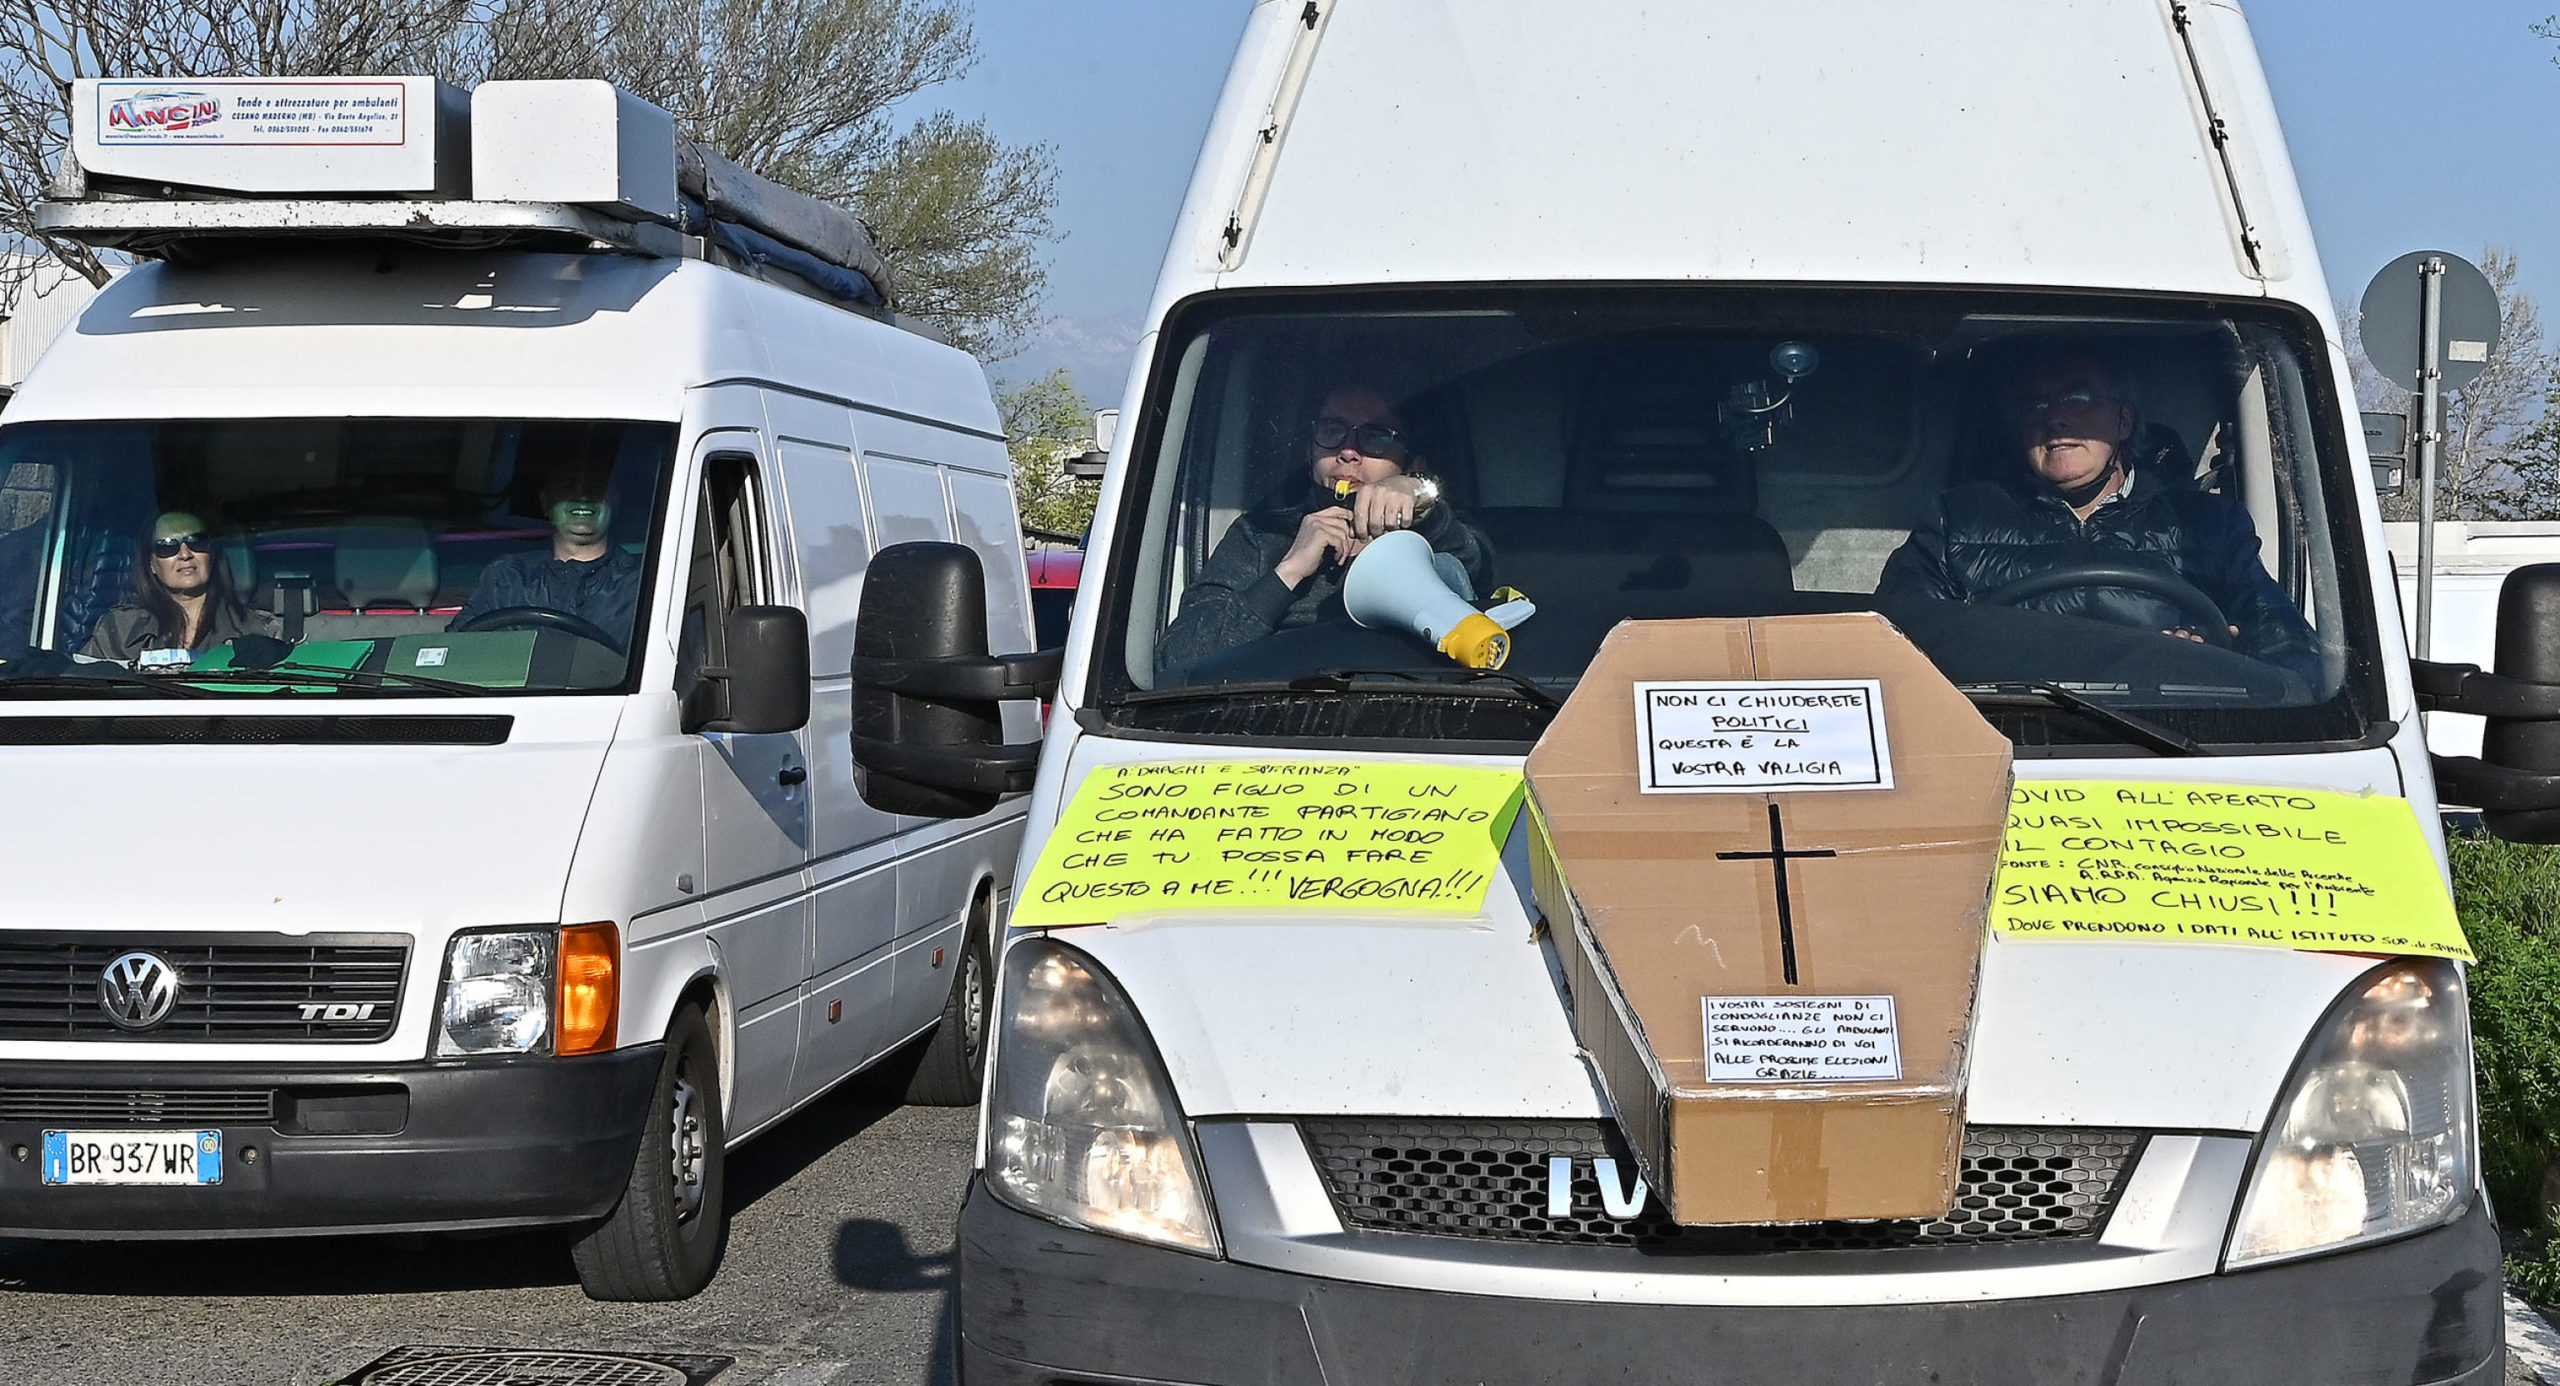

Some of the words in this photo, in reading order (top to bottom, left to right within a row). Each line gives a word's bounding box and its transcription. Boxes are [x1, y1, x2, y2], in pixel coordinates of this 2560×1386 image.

[237, 97, 262, 107] Tende
[275, 97, 329, 107] attrezzature
[334, 100, 348, 109] per
[352, 97, 398, 107] ambulanti
[110, 101, 216, 128] MANCINI
[1656, 694, 1698, 707] NON
[1706, 695, 1726, 707] CI
[1737, 694, 1863, 709] CHIUDERETE
[1712, 716, 1808, 730] POLITICI
[1658, 738, 1732, 751] QUESTA
[1773, 738, 1800, 749] LA
[1671, 760, 1746, 777] VOSTRA
[1757, 760, 1842, 776] VALIGIA
[1098, 782, 1188, 801] SONO
[1213, 782, 1305, 797] FIGLIO
[1333, 782, 1370, 796] DI
[1408, 784, 1458, 798] UN
[2010, 788, 2086, 804] OVID
[1095, 805, 1270, 822] COMANDANTE
[1296, 804, 1489, 823] PARTIGIANO
[1075, 829, 1133, 844] CHE
[1149, 828, 1185, 842] HA
[1216, 826, 1303, 842] FATTO
[1318, 829, 1348, 841] IN
[1370, 828, 1445, 845] MODO
[2008, 812, 2103, 831] QUASI
[2125, 816, 2348, 846] IMPOSSIBILE
[2004, 839, 2046, 852] IL
[2061, 837, 2245, 859] CONTAGIO
[1062, 852, 1129, 870] CHE
[1152, 851, 1190, 865] TU
[1221, 849, 1325, 863] POSSA
[1346, 848, 1433, 864] FARE
[2264, 866, 2298, 879] delle
[1041, 880, 1151, 903] QUESTO
[1161, 880, 1181, 896] A
[2278, 879, 2304, 891] per
[2002, 883, 2127, 906] SIAMO
[2007, 917, 2056, 932] DOVE
[2061, 919, 2166, 933] PRENDONO
[2177, 923, 2184, 934] I
[2190, 924, 2237, 936] DATI
[298, 1004, 376, 1020] TDI
[1710, 1002, 1715, 1010] I
[1718, 1000, 1765, 1009] VOSTRI
[1772, 1000, 1842, 1010] SOSTEGNI
[1854, 1000, 1870, 1011] DI
[1832, 1012, 1865, 1022] NON
[1869, 1013, 1884, 1021] CI
[1711, 1036, 1729, 1046] SI
[1832, 1039, 1846, 1048] DI
[1854, 1039, 1876, 1050] VOI
[1713, 1051, 1754, 1065] ALLE
[1824, 1054, 1888, 1066] ELEZIONI
[71, 1143, 101, 1173] BR
